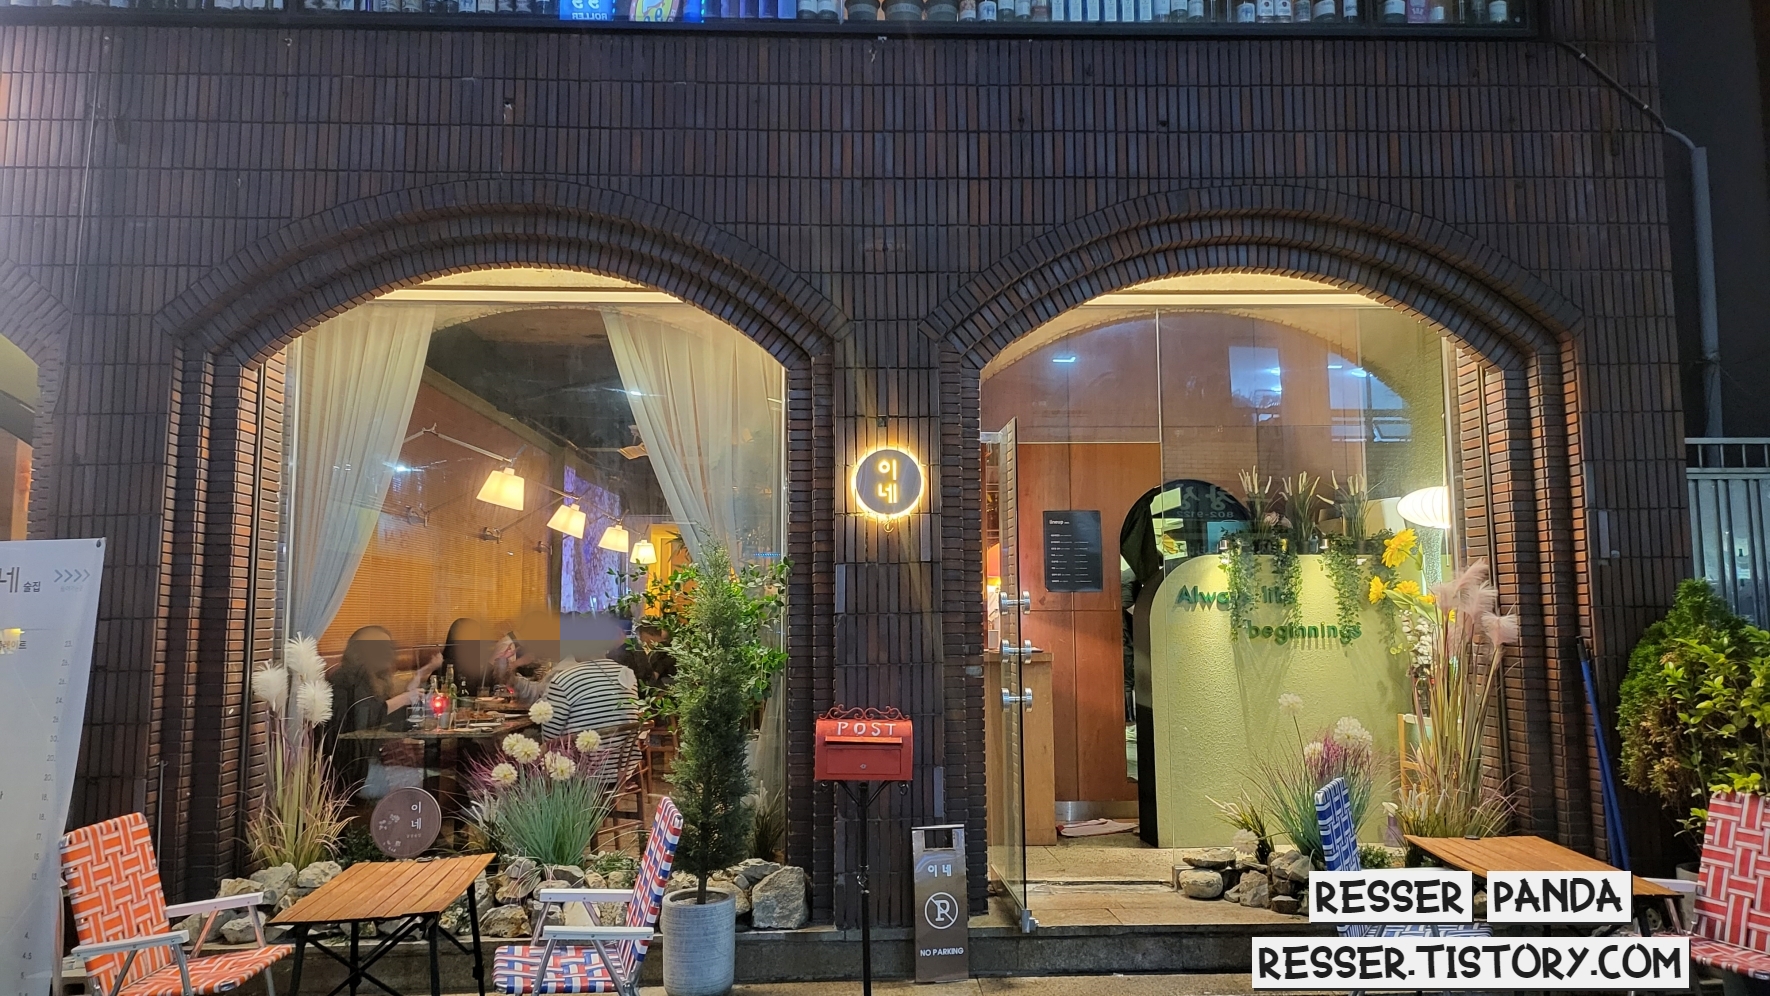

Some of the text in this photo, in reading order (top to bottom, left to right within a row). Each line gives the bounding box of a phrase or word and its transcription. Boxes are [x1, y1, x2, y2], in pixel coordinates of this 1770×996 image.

[23, 581, 41, 593] 술집
[1244, 619, 1362, 645] beginnings
[837, 721, 896, 736] POST
[920, 947, 964, 957] NO PARKING
